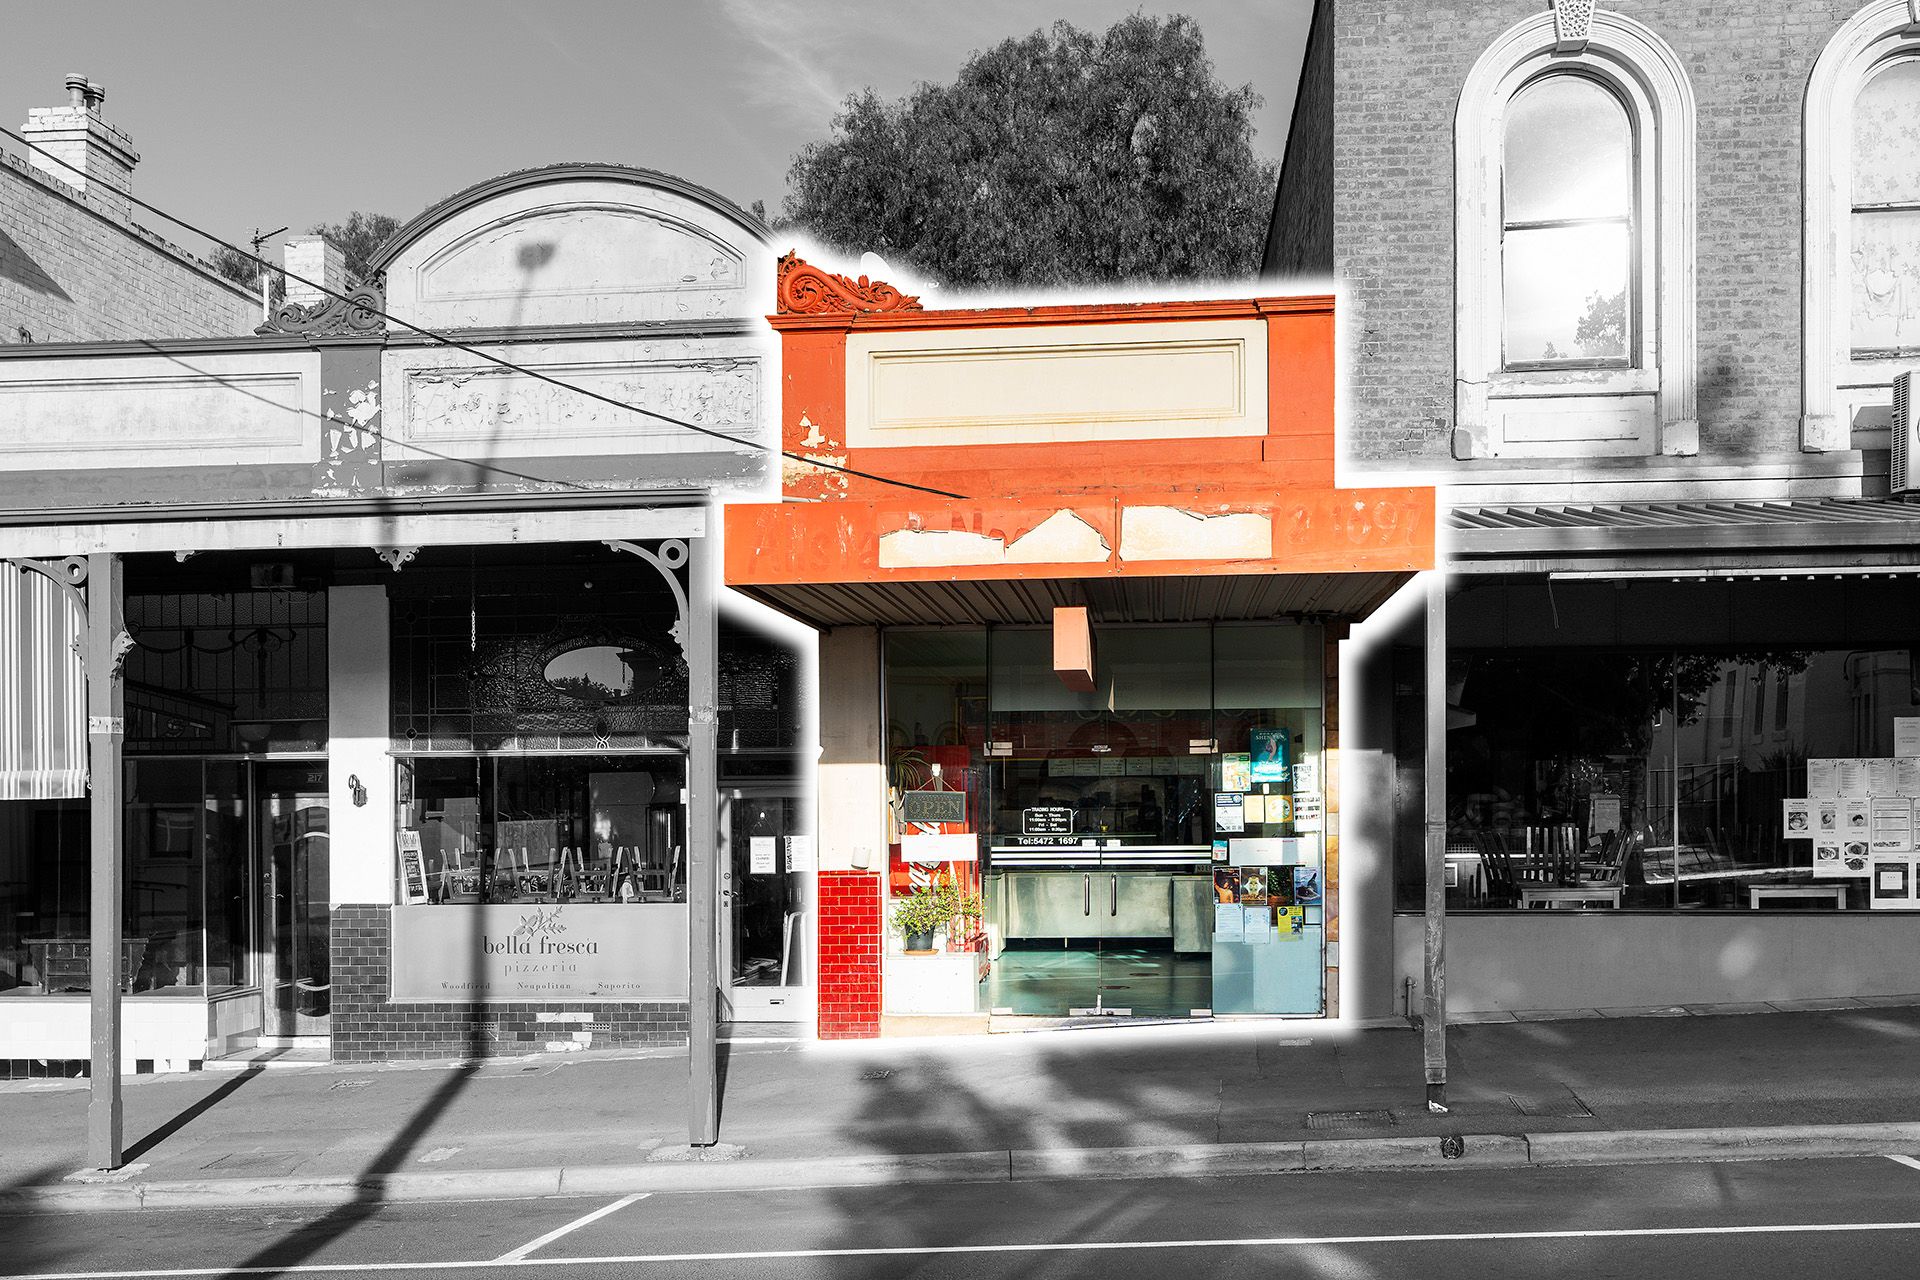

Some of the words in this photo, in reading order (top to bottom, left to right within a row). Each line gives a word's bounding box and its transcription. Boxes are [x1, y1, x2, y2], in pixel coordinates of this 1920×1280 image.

[307, 774, 323, 783] 217
[909, 799, 961, 815] OPEN
[1017, 837, 1054, 845] Tel:5472
[1058, 837, 1079, 845] 1697
[482, 935, 531, 955] bella
[538, 935, 600, 955] fresca
[504, 961, 577, 977] pizzeria
[441, 981, 491, 990] Woodfired
[517, 982, 571, 991] Neapolitan
[598, 981, 641, 991] Saporito
